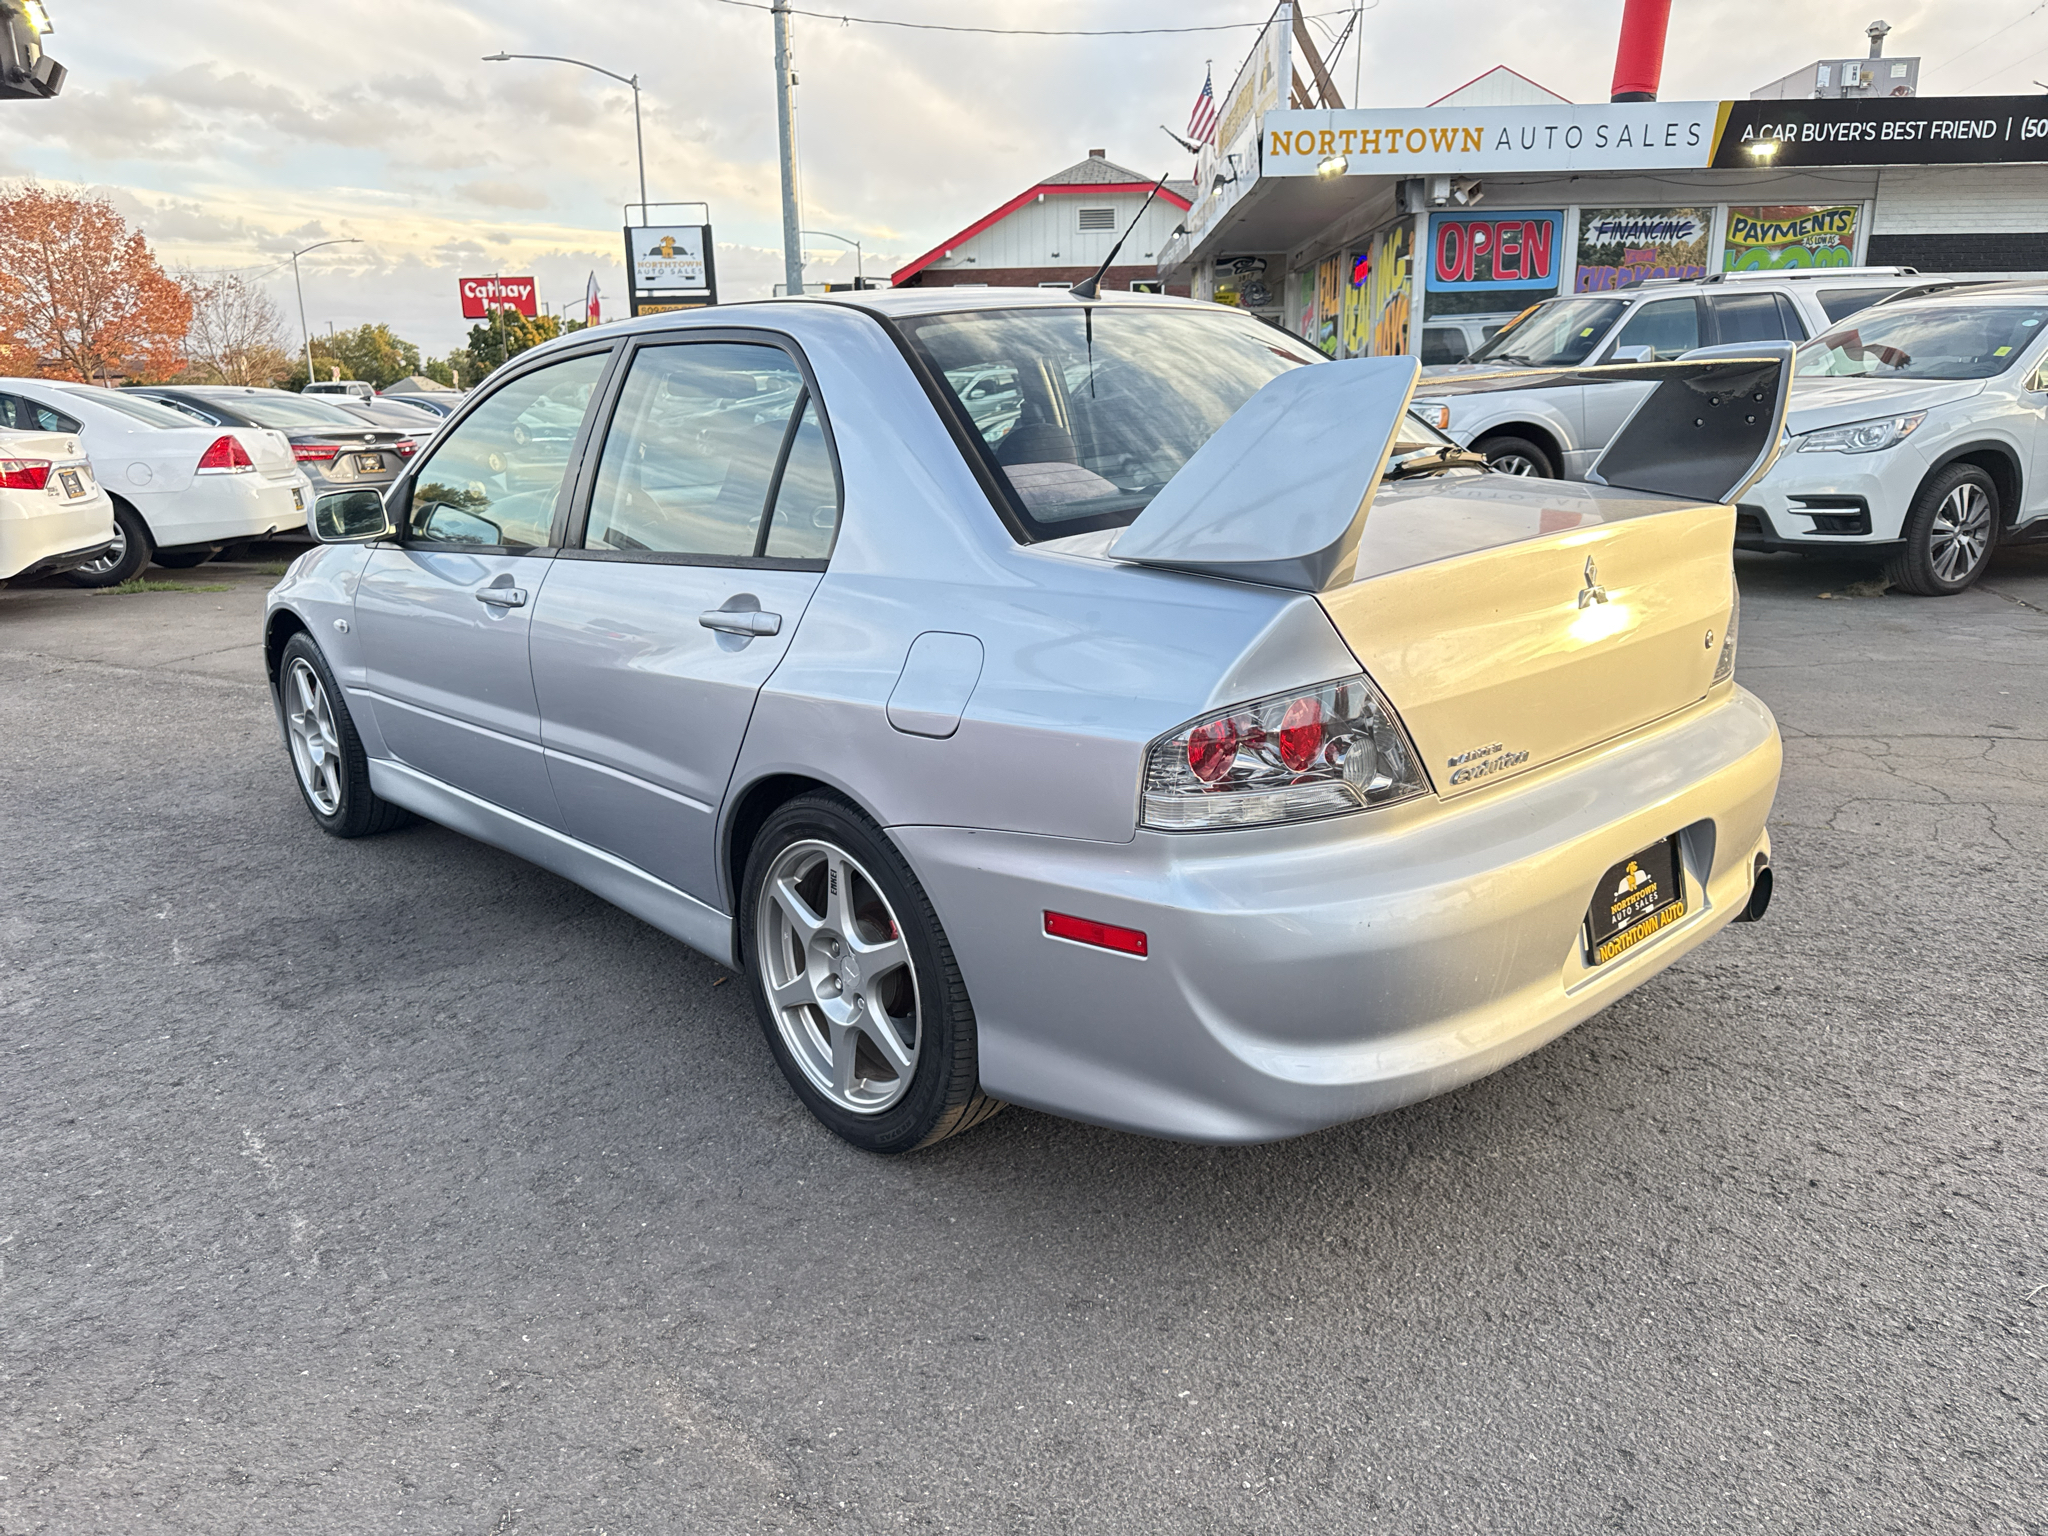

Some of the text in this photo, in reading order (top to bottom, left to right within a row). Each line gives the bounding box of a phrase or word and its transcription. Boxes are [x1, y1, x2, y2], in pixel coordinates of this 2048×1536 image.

[1270, 122, 1701, 156] NORTHTOWN AUTO SALES
[1740, 123, 1754, 142] A
[1760, 123, 1798, 142] CAR
[1801, 121, 1877, 142] BUYER'S
[1880, 120, 1928, 140] BEST
[1930, 119, 1997, 140] FRIEND
[1596, 221, 1693, 241] FINANCING
[1732, 210, 1851, 242] PAYMENTS
[1436, 221, 1552, 282] OPEN
[464, 280, 532, 301] Cathay
[830, 868, 838, 896] ENKEI
[1610, 882, 1657, 914] NORTHTOWN
[1611, 891, 1658, 924] AUTO SALES
[1600, 902, 1684, 960] NORTHTOWN AUTO
